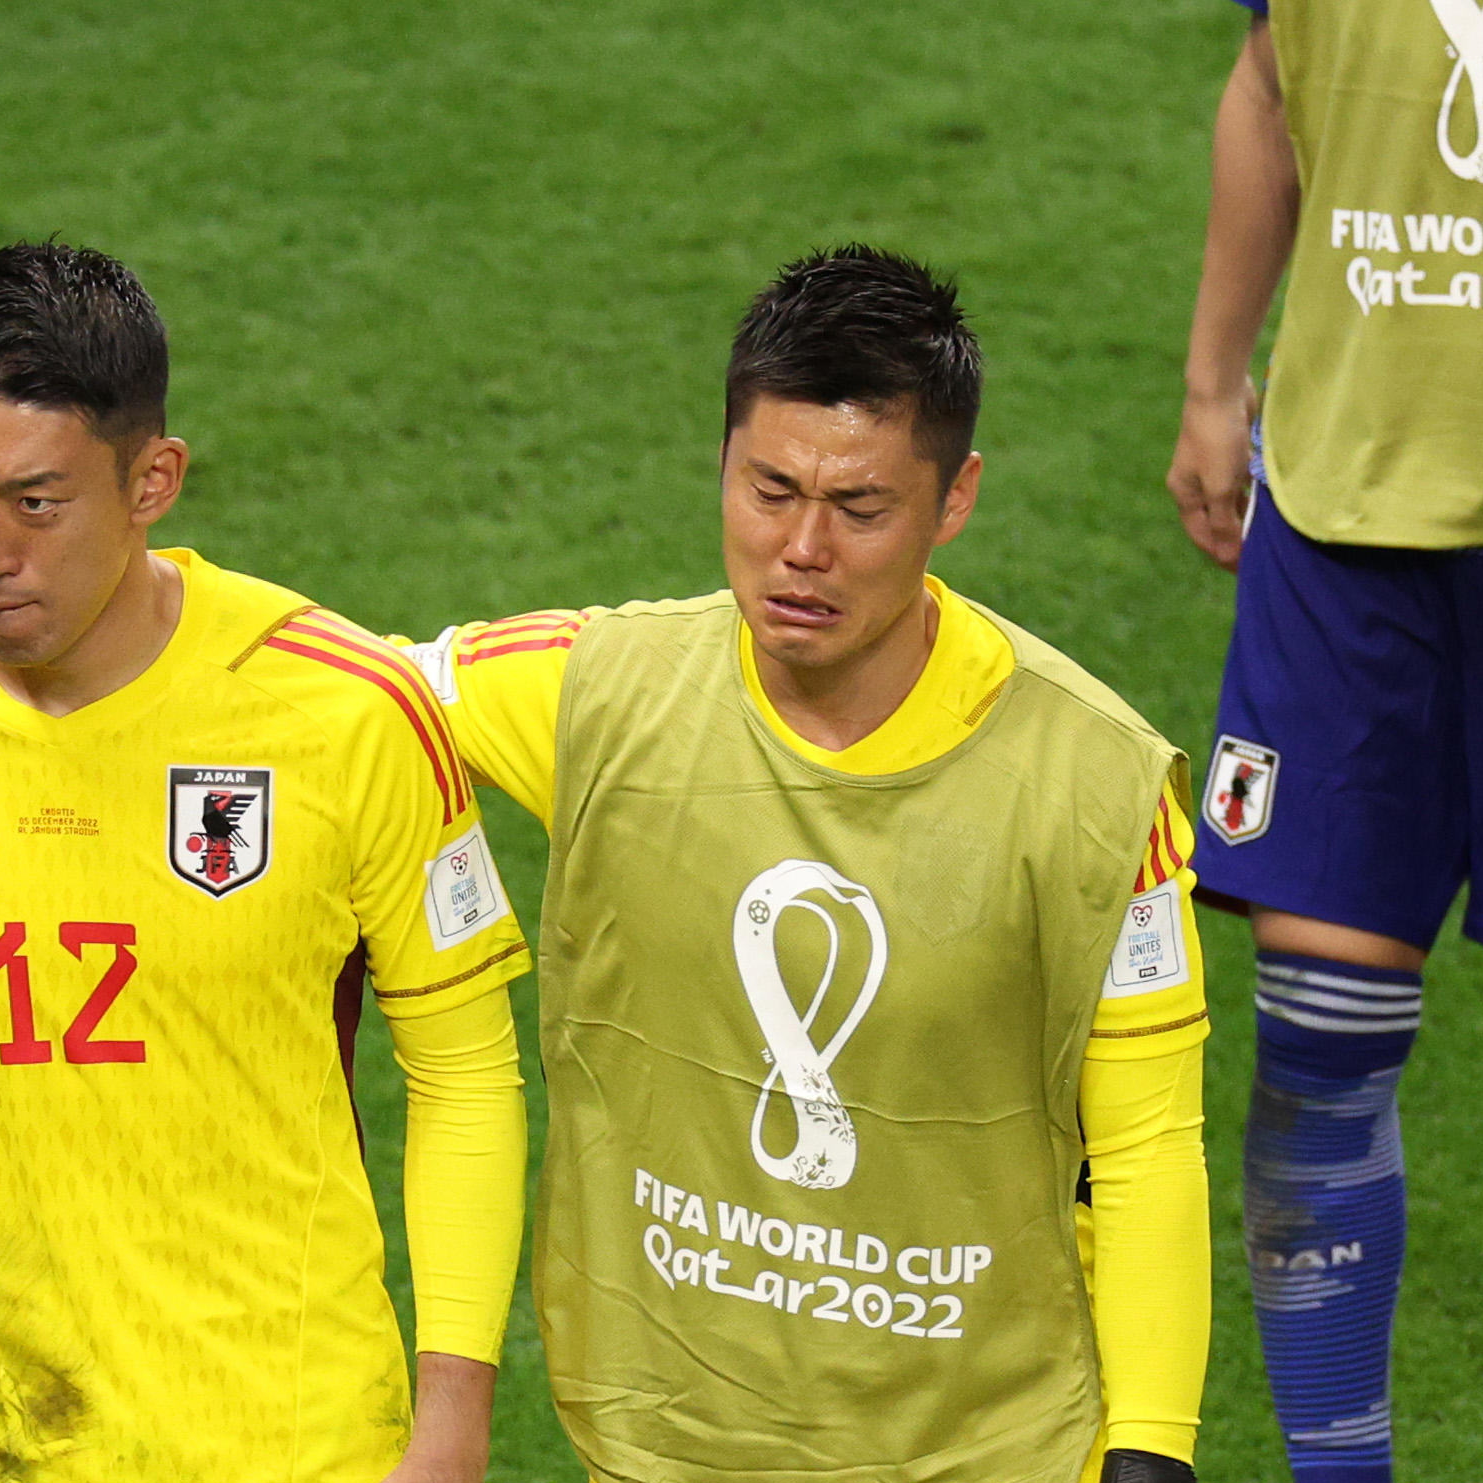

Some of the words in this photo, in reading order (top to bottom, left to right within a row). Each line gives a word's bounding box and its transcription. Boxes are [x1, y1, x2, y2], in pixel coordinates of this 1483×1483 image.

[1331, 208, 1400, 253] FIFA
[193, 771, 247, 784] JAPAN
[76, 818, 98, 828] 2022
[451, 884, 478, 906] UNITES
[1129, 938, 1162, 957] UNITES
[634, 1167, 709, 1236] FIFA
[716, 1201, 889, 1274] WORLD
[896, 1244, 993, 1285] CUP
